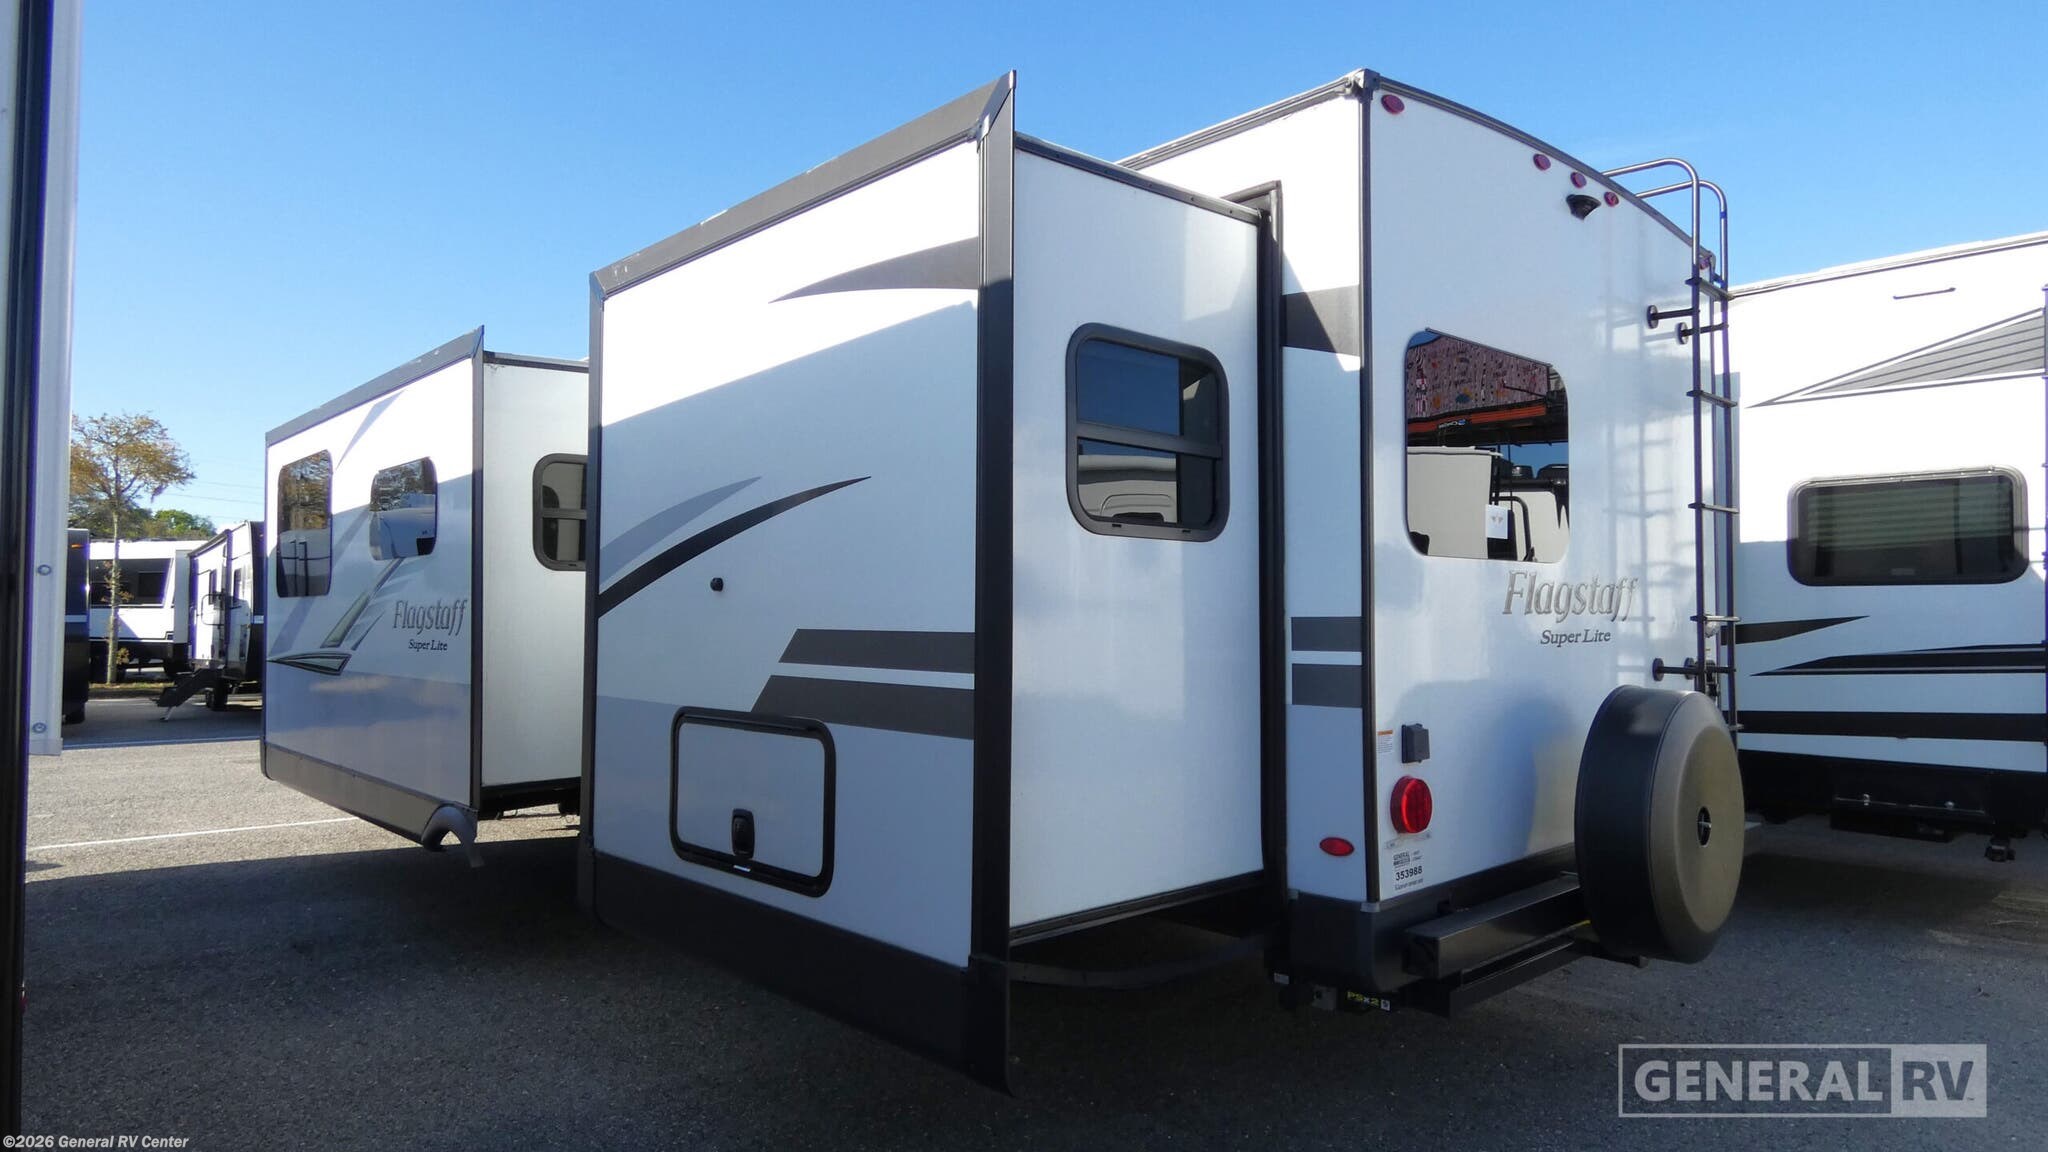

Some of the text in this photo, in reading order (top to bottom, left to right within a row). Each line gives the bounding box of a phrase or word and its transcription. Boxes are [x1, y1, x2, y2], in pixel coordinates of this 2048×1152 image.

[1502, 569, 1639, 623] Flagstaff
[392, 598, 468, 636] Flagstaff
[408, 639, 448, 652] Super Lite
[1540, 628, 1611, 648] Super Lite
[1395, 865, 1423, 881] 353988
